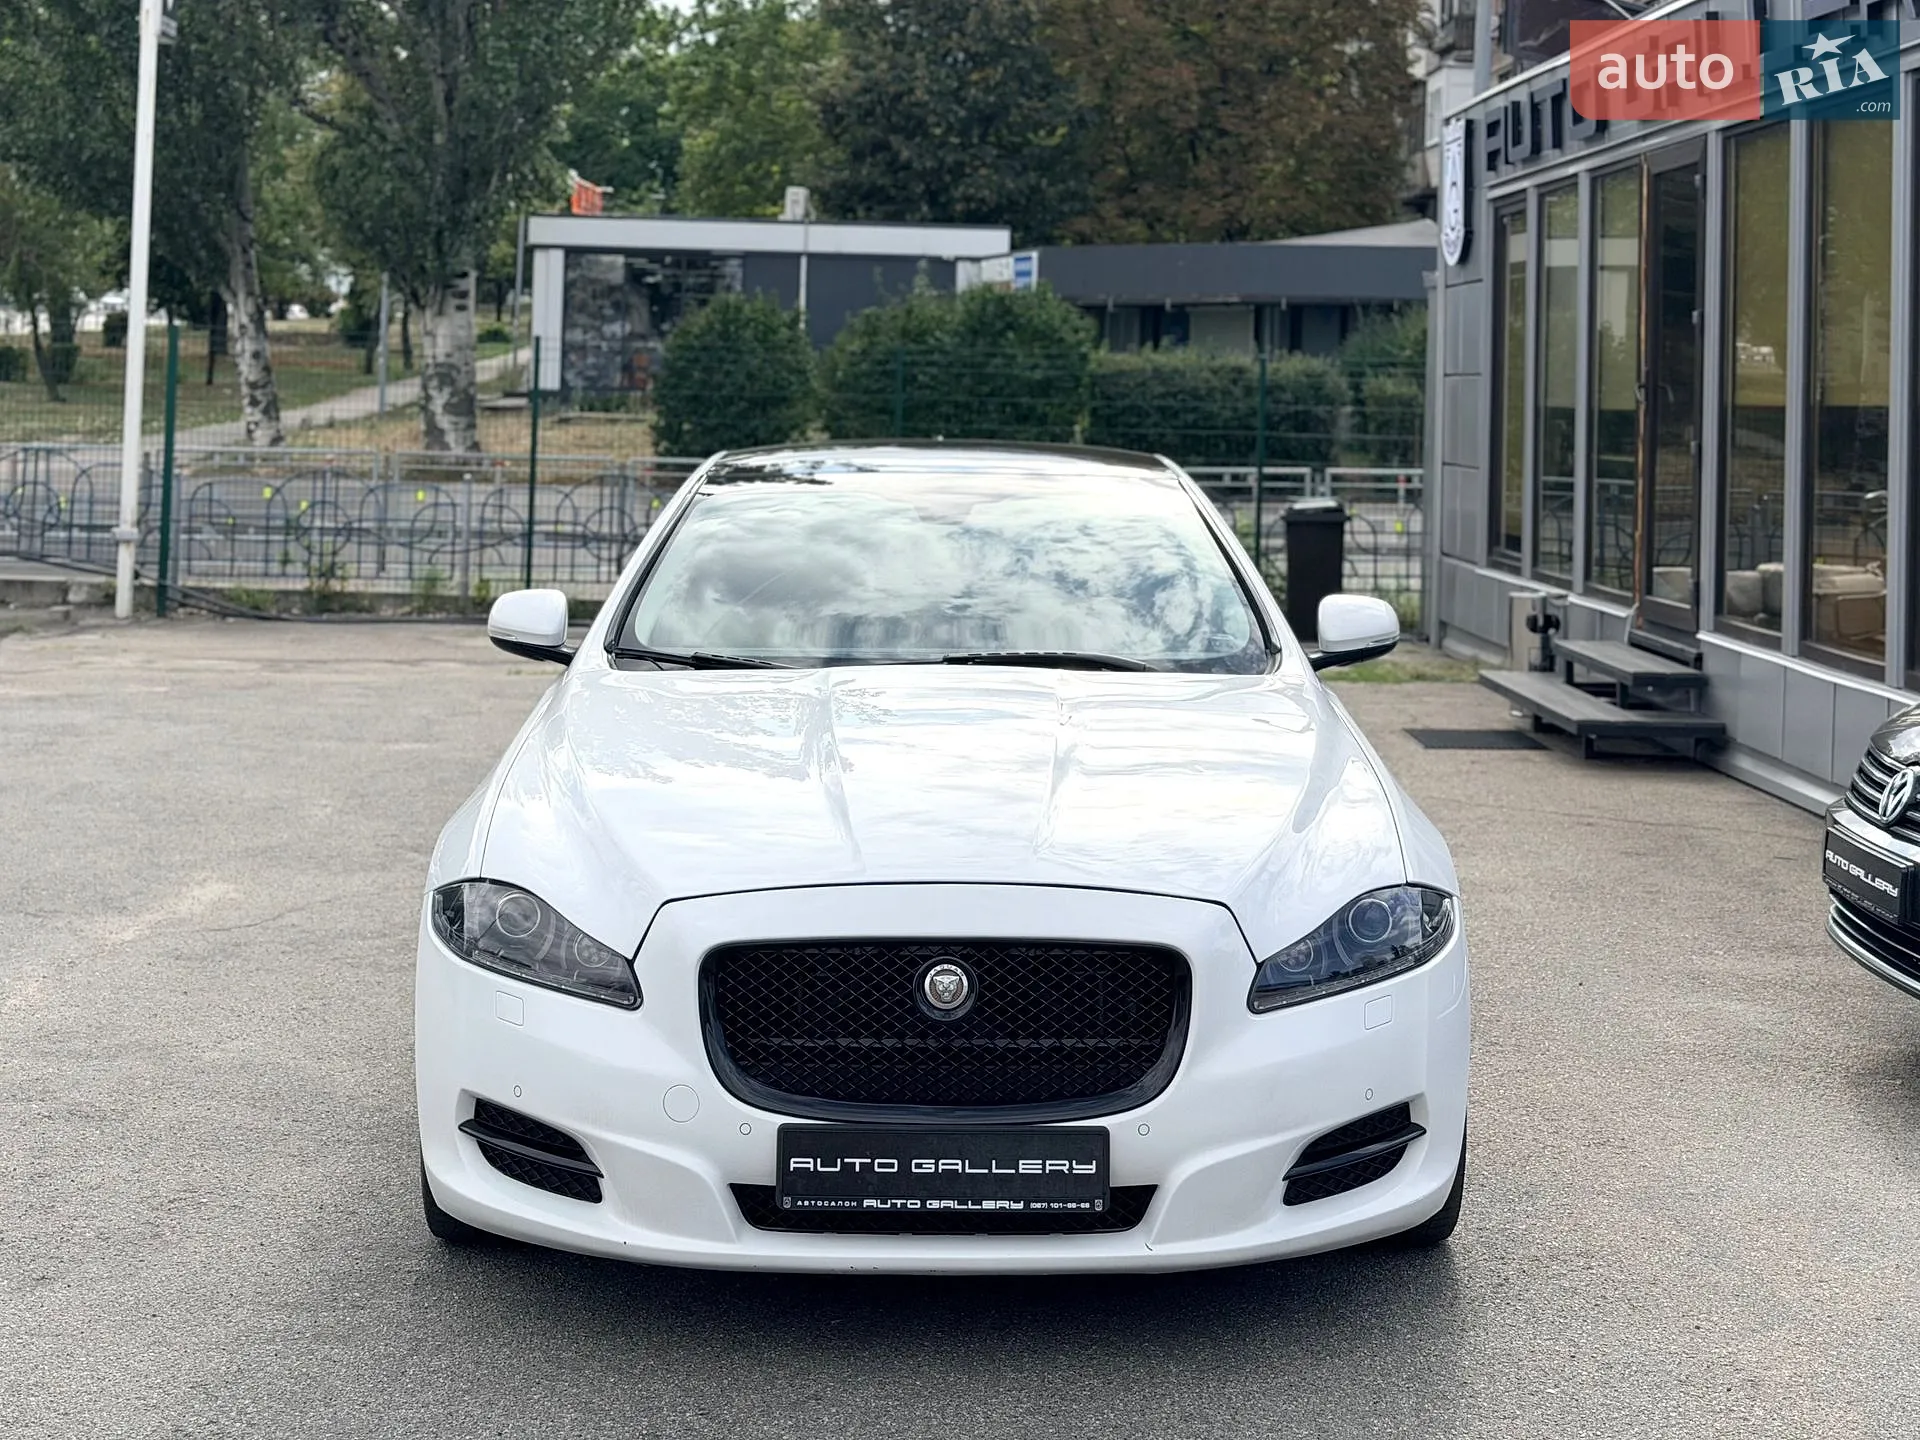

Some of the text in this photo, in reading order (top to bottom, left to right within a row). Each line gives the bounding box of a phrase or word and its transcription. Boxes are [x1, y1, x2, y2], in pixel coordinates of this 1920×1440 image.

[1825, 849, 1899, 897] AUTO GALLERY
[789, 1157, 1097, 1174] AUTO GALLERY
[863, 1199, 921, 1209] AUTO
[926, 1199, 1024, 1210] GALLERY
